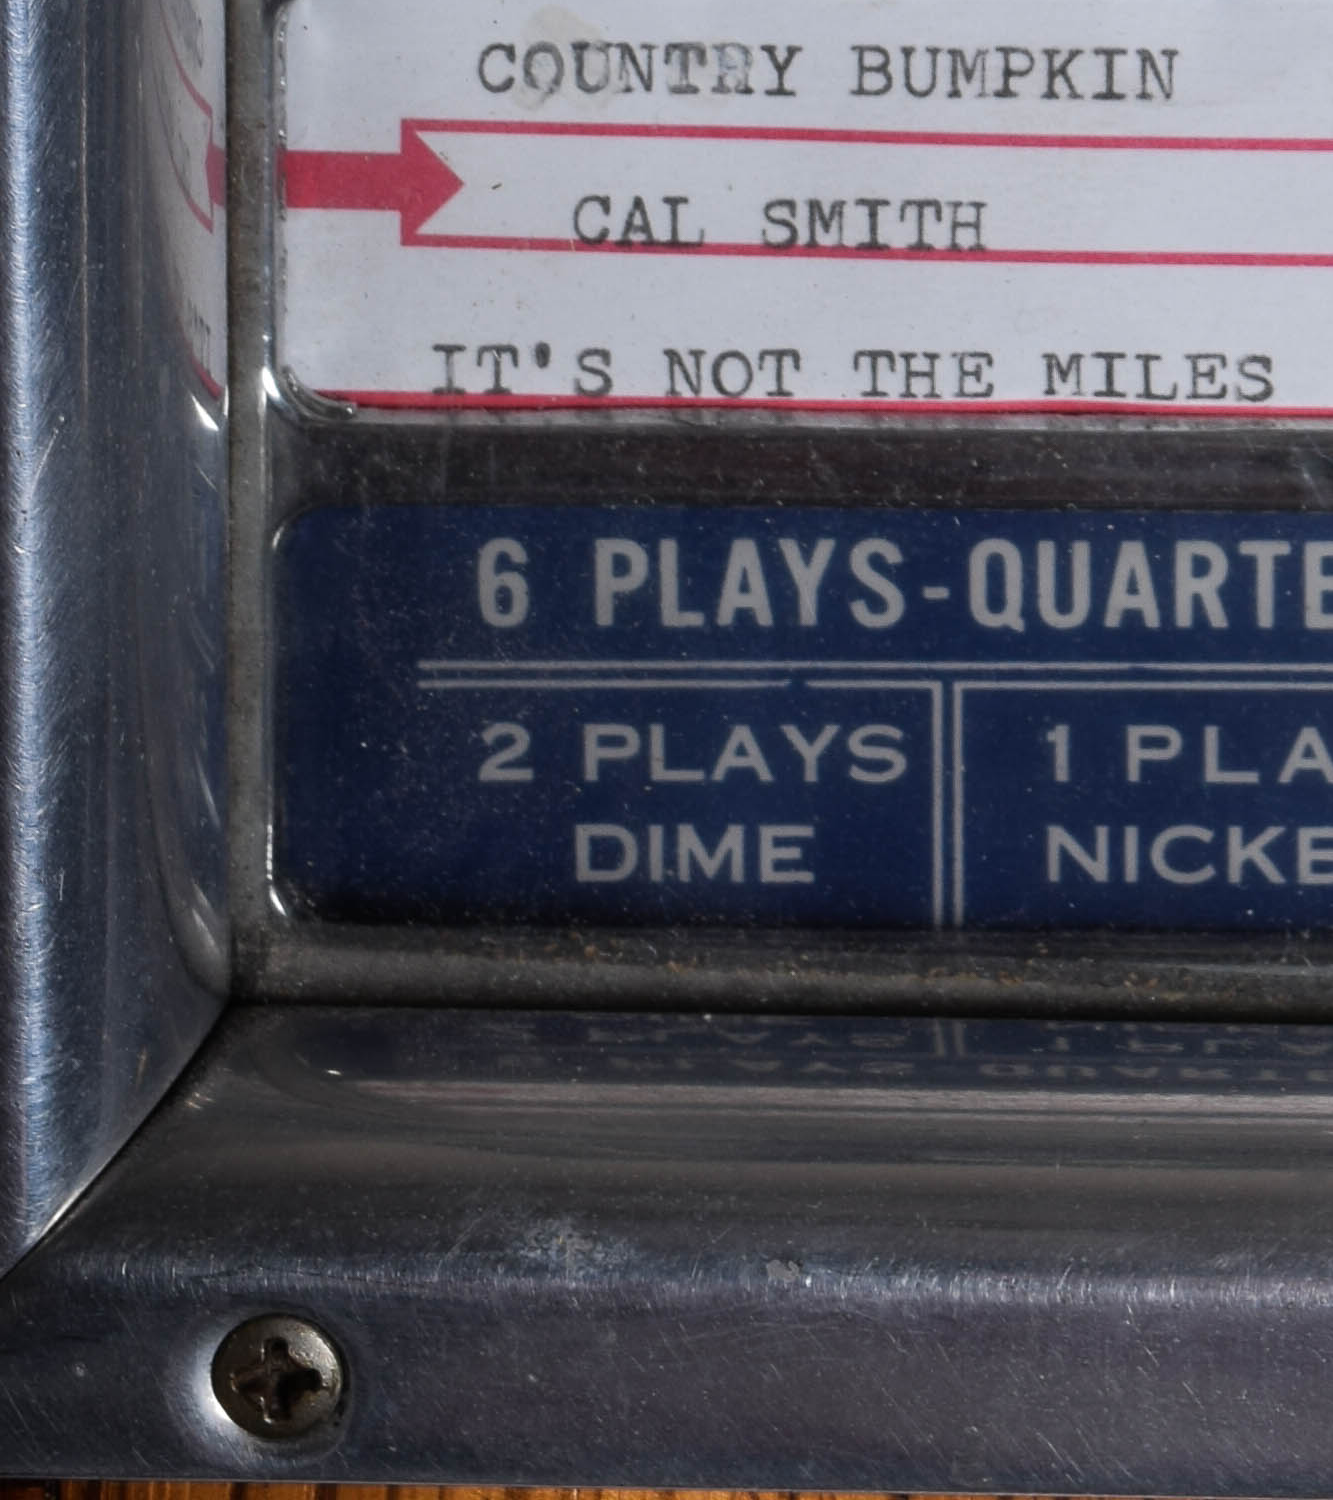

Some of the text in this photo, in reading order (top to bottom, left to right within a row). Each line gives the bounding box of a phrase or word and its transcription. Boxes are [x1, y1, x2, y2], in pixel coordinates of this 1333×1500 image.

[477, 40, 1179, 101] COUNTRY BUMPKIN
[573, 195, 1000, 250] CAL SMITH
[426, 341, 1274, 403] IT'S NOT THE MILES
[478, 538, 528, 627] 6
[479, 722, 906, 783] 2 PLAYS
[1047, 725, 1069, 782] 1
[576, 824, 813, 882] DIME
